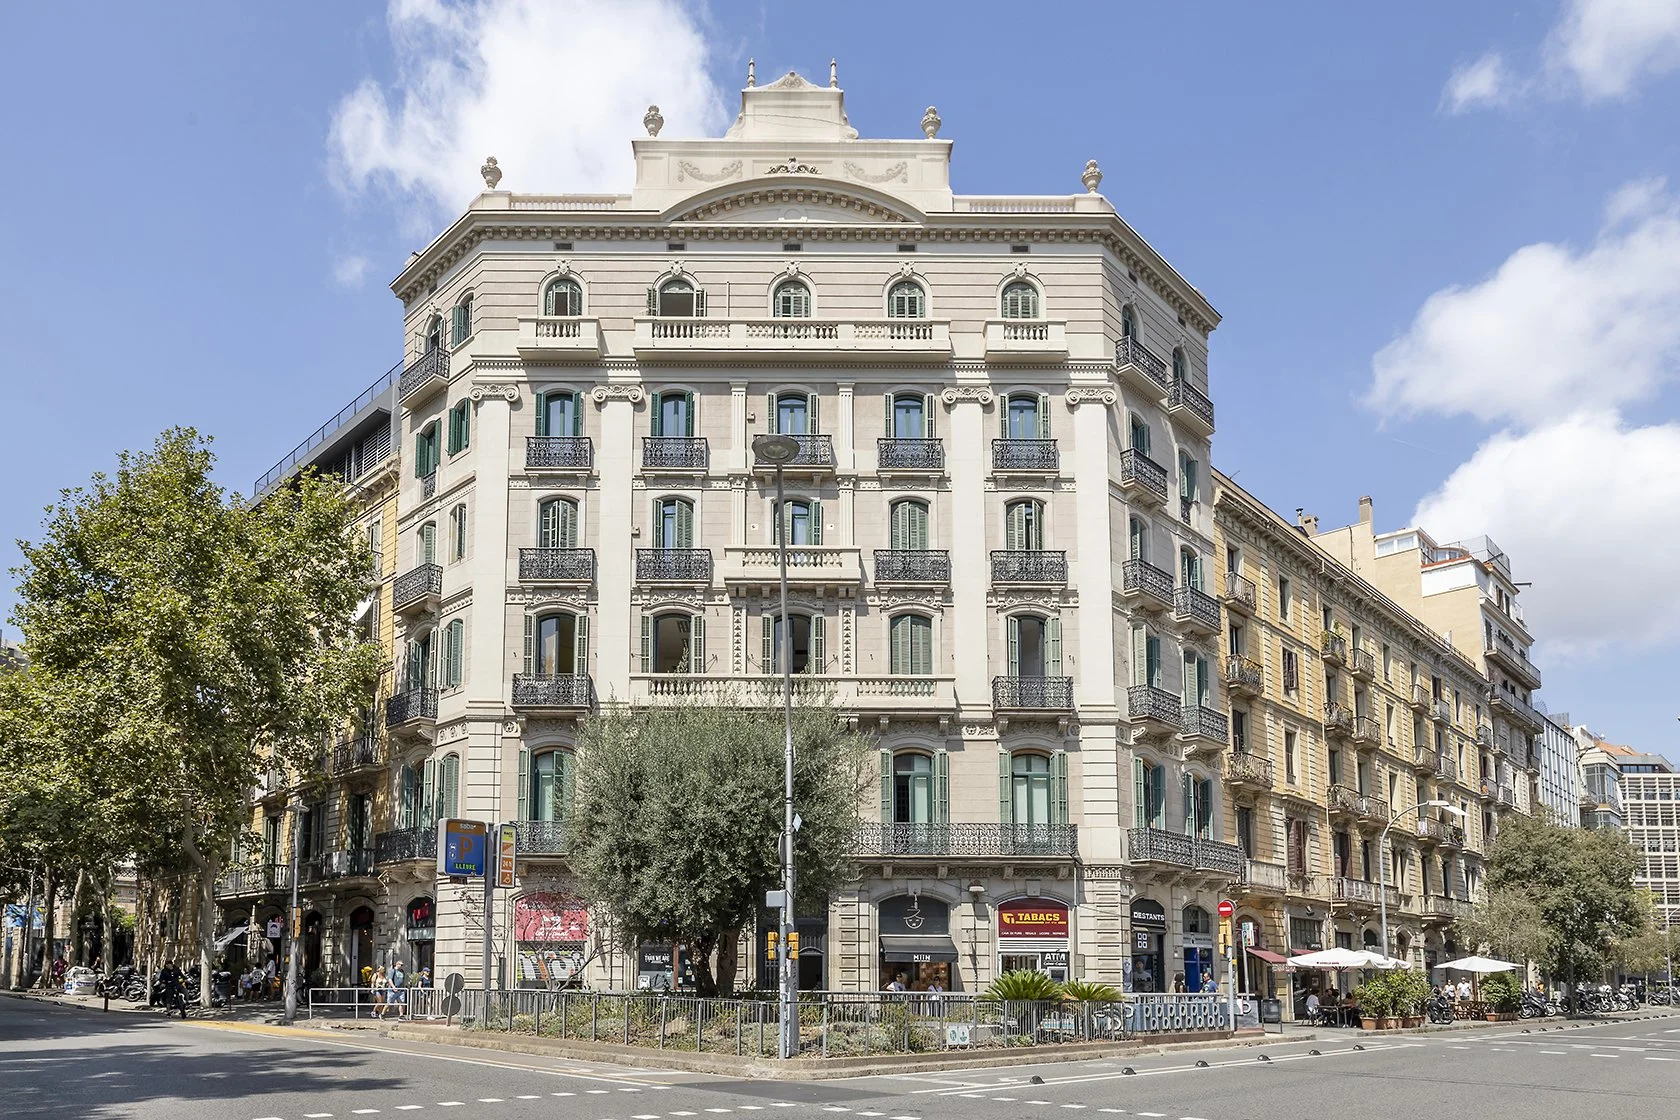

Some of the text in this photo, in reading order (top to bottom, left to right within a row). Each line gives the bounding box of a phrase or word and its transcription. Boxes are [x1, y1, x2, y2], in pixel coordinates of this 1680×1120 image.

[460, 836, 472, 860] P
[1017, 913, 1060, 921] TABACS
[1045, 953, 1066, 961] ATM
